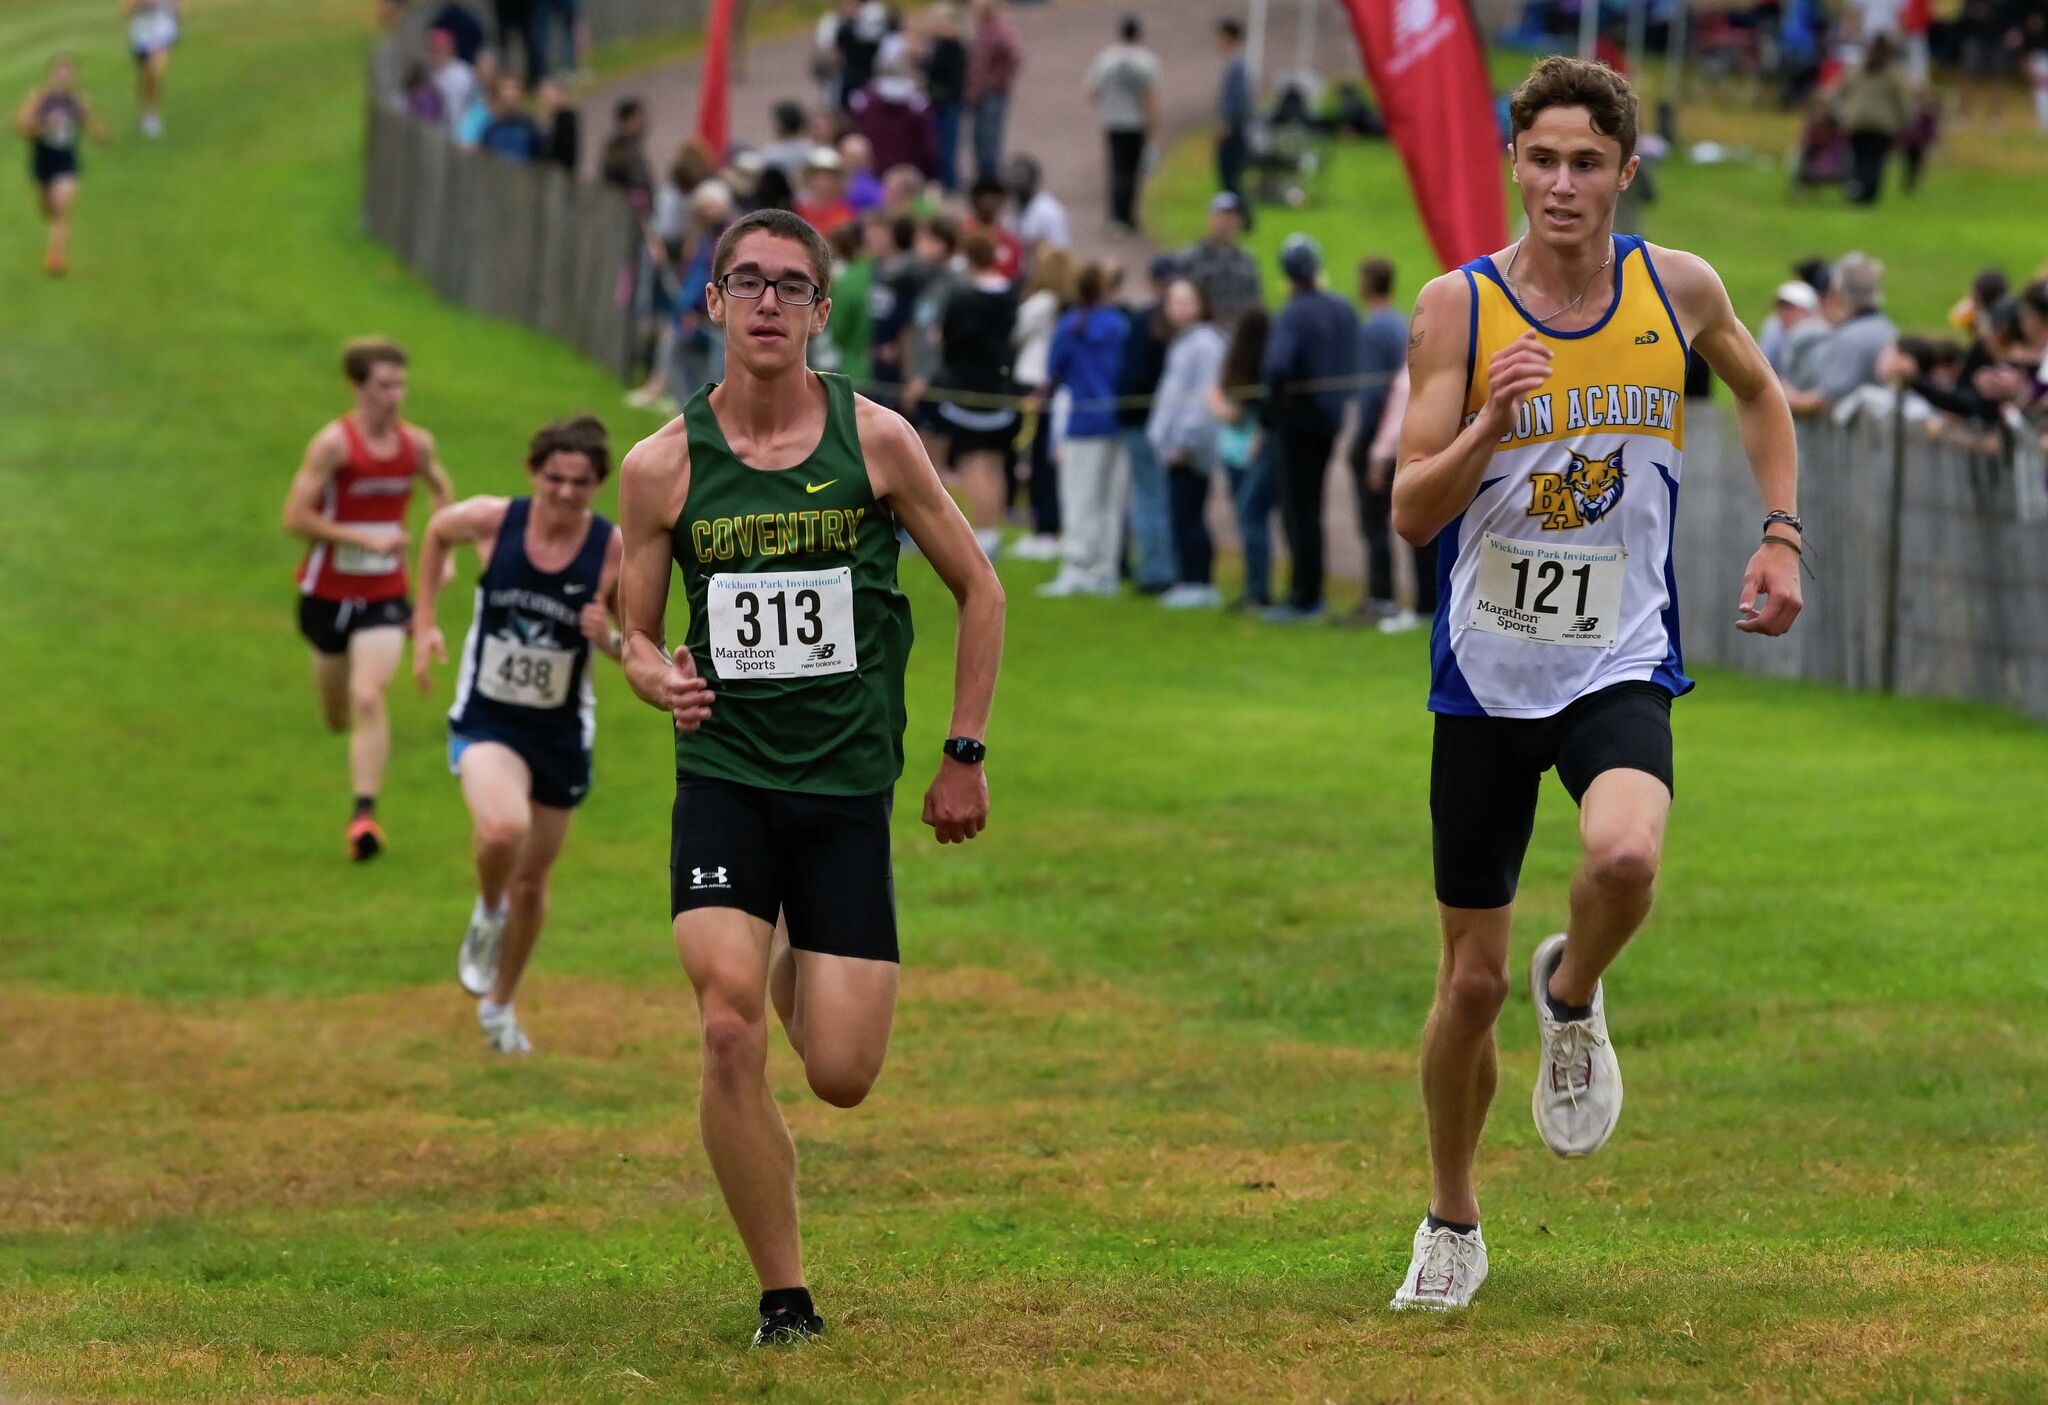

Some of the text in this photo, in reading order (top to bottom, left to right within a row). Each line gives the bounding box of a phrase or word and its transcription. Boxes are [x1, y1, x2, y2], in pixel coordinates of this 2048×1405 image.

[691, 507, 865, 563] COVENTRY
[1490, 539, 1617, 563] Wickham Park Invitational
[716, 575, 841, 590] Wickham Park Invitational
[1510, 558, 1591, 616] 121
[735, 589, 823, 647] 313
[1476, 599, 1539, 623] Marathon
[1496, 614, 1537, 634] Sports
[715, 647, 775, 659] Marathon
[815, 659, 842, 668] balance
[497, 653, 552, 691] 438
[735, 660, 775, 672] Sports
